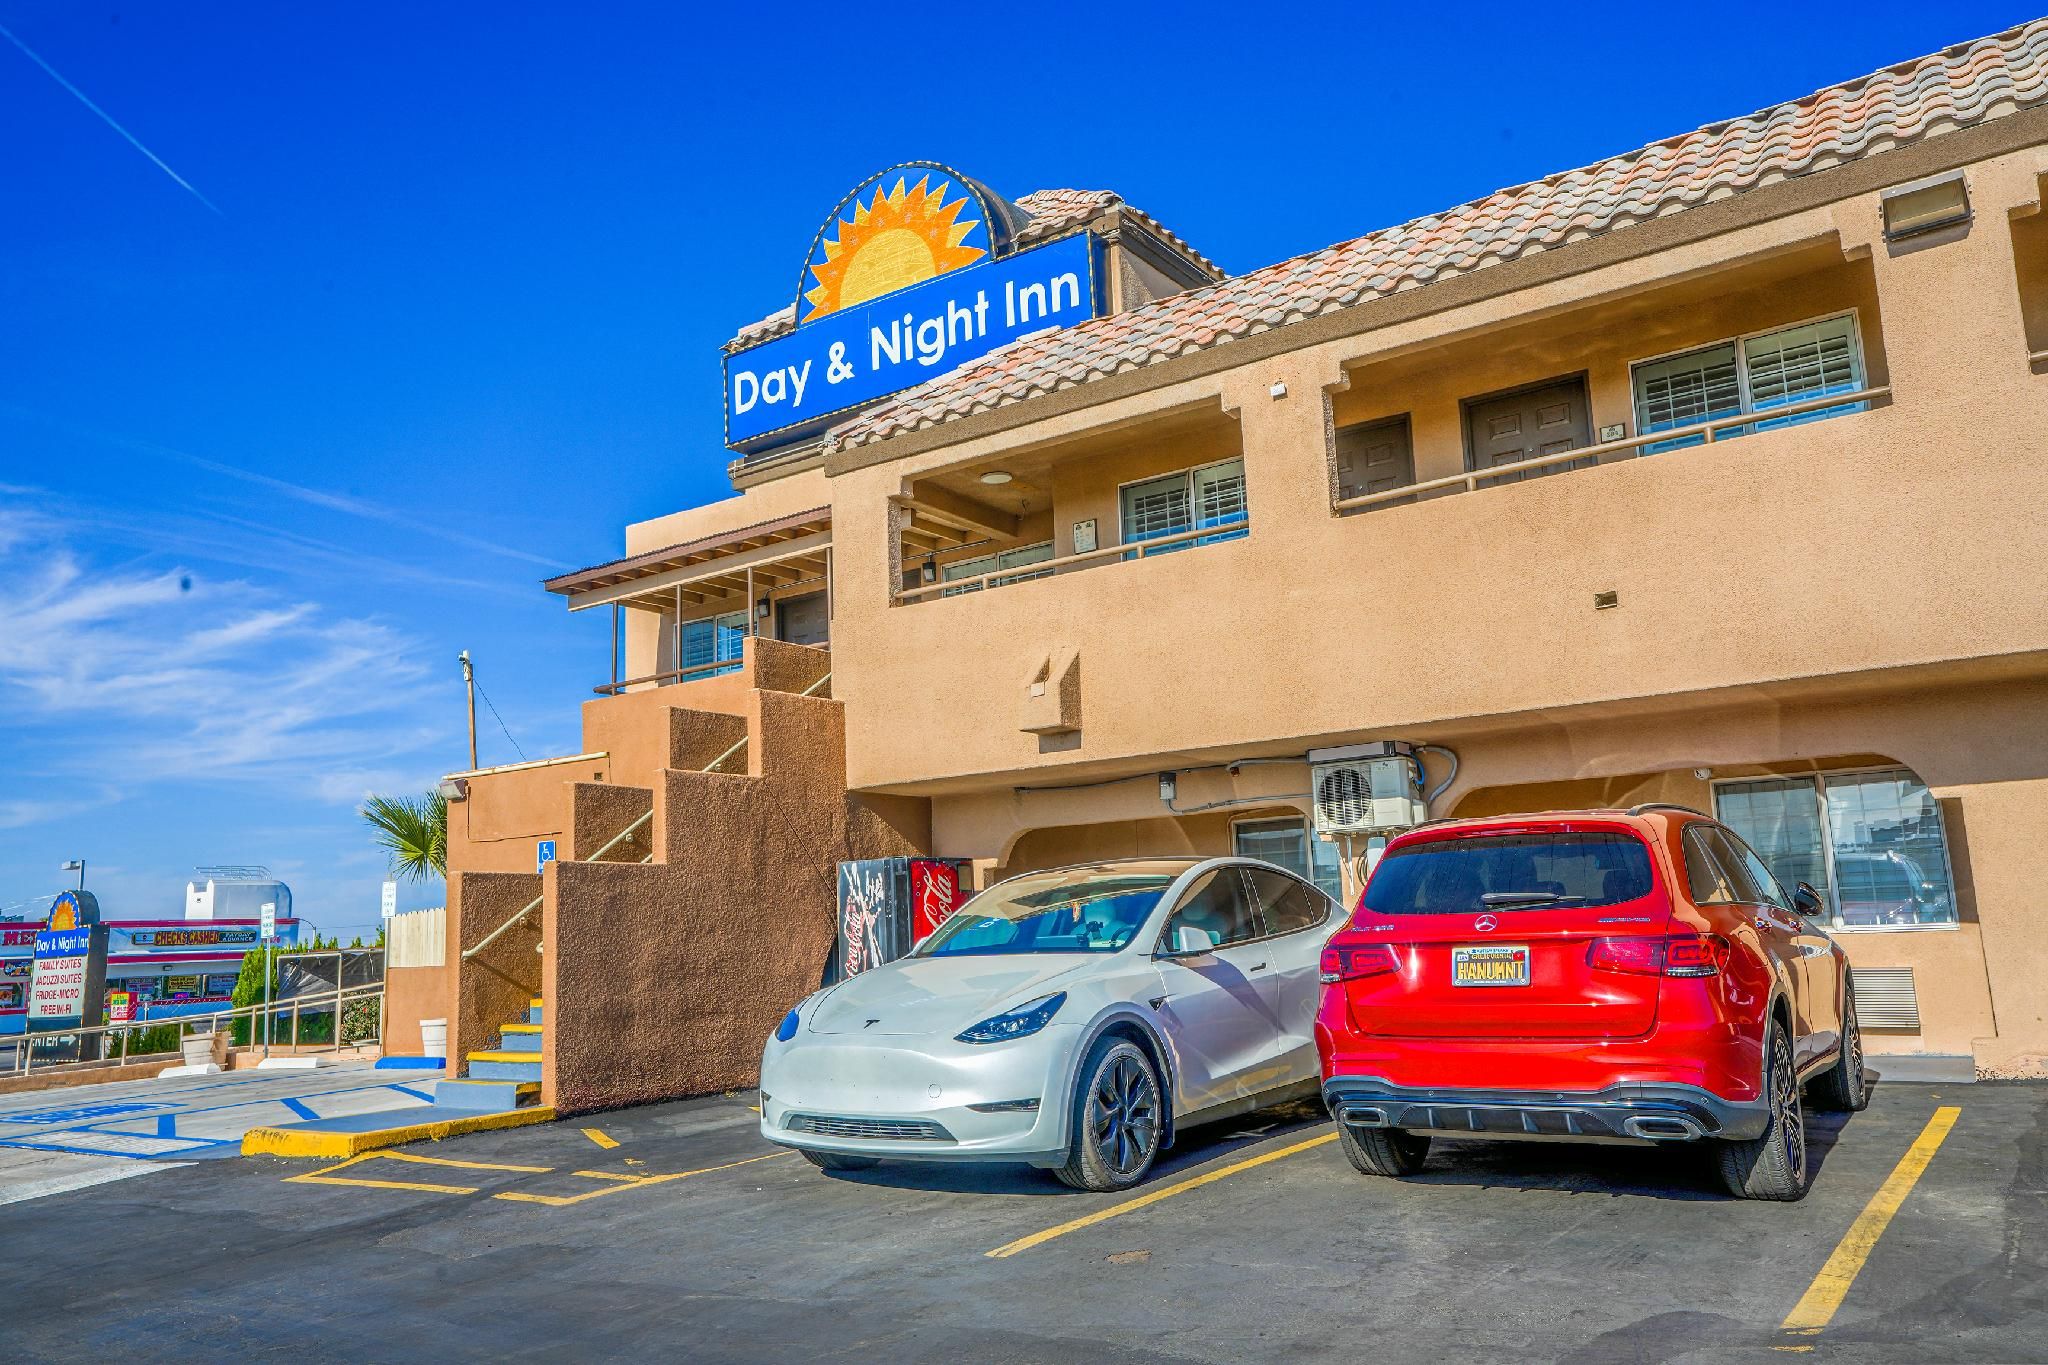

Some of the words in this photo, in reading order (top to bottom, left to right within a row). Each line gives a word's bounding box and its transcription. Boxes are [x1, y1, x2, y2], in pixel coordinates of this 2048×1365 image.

[734, 359, 812, 415] Day
[826, 340, 855, 385] &
[870, 290, 990, 371] Night
[1005, 271, 1081, 328] Inn
[36, 940, 50, 953] Day
[51, 938, 57, 951] &
[58, 937, 76, 952] Night
[77, 935, 89, 948] Inn
[155, 931, 187, 945] CHECKS
[188, 930, 219, 944] CASHED
[39, 960, 59, 971] FAMILY
[60, 958, 82, 970] SUITES
[36, 975, 60, 986] JACUZZI
[61, 973, 82, 984] SUITES
[41, 1004, 56, 1015] FREE
